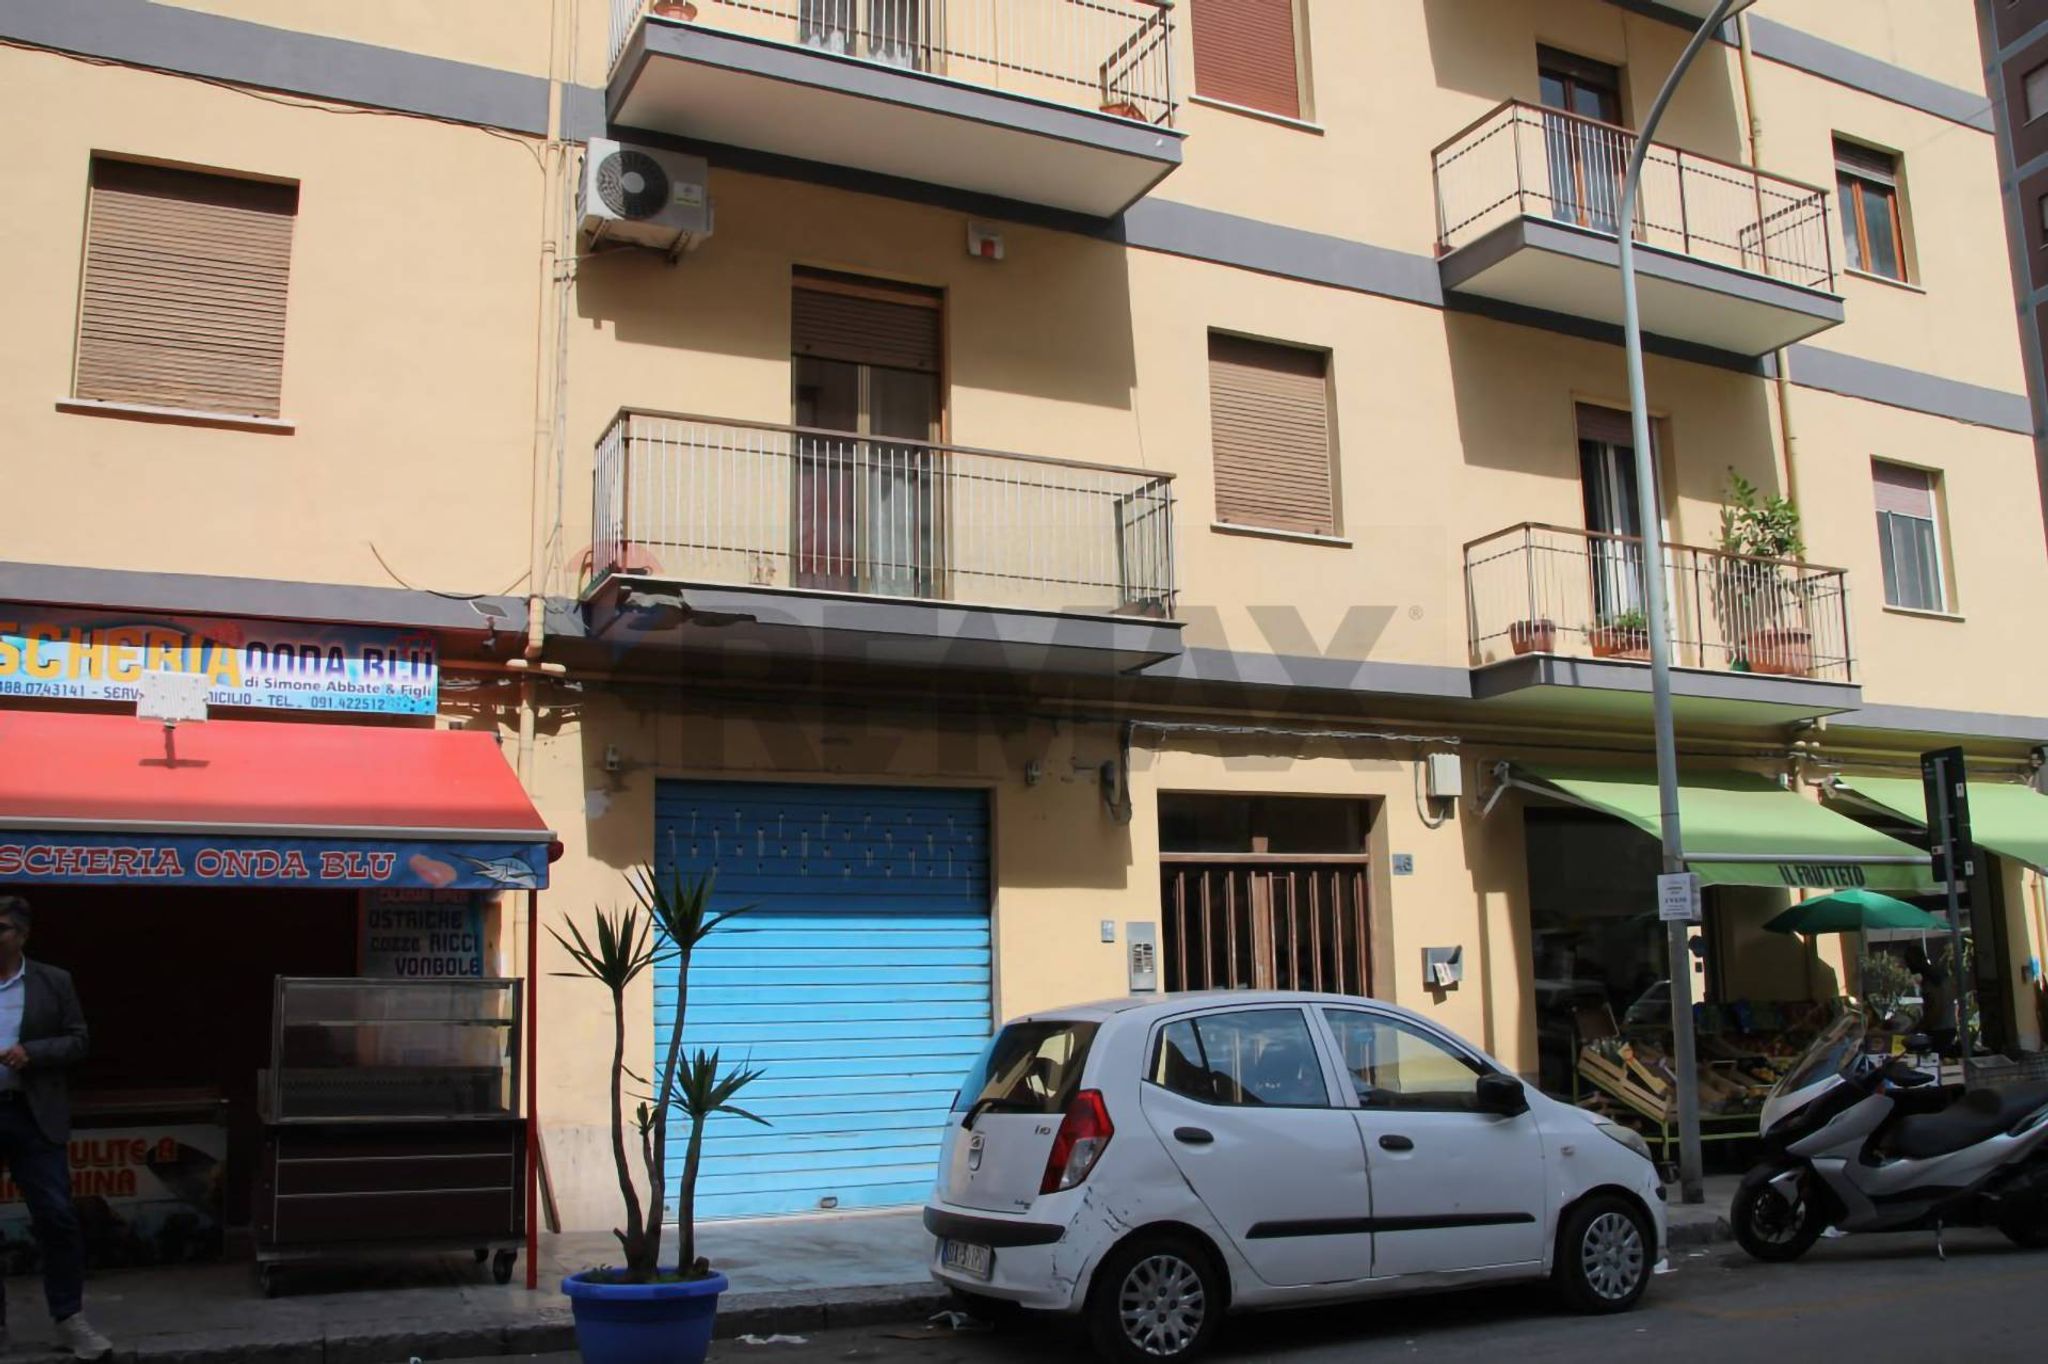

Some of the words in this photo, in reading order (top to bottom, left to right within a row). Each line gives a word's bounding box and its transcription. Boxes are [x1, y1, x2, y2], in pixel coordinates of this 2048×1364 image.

[104, 686, 140, 699] SERV
[244, 677, 259, 689] di
[264, 677, 321, 692] Simone
[326, 680, 380, 694] Abbate
[386, 683, 396, 695] &
[401, 684, 432, 698] Figli
[0, 844, 183, 877] SCHERIA
[195, 848, 309, 879] ONDA
[320, 850, 396, 880] BLU
[368, 909, 463, 930] OSTRICHE
[429, 933, 479, 953] RICCI
